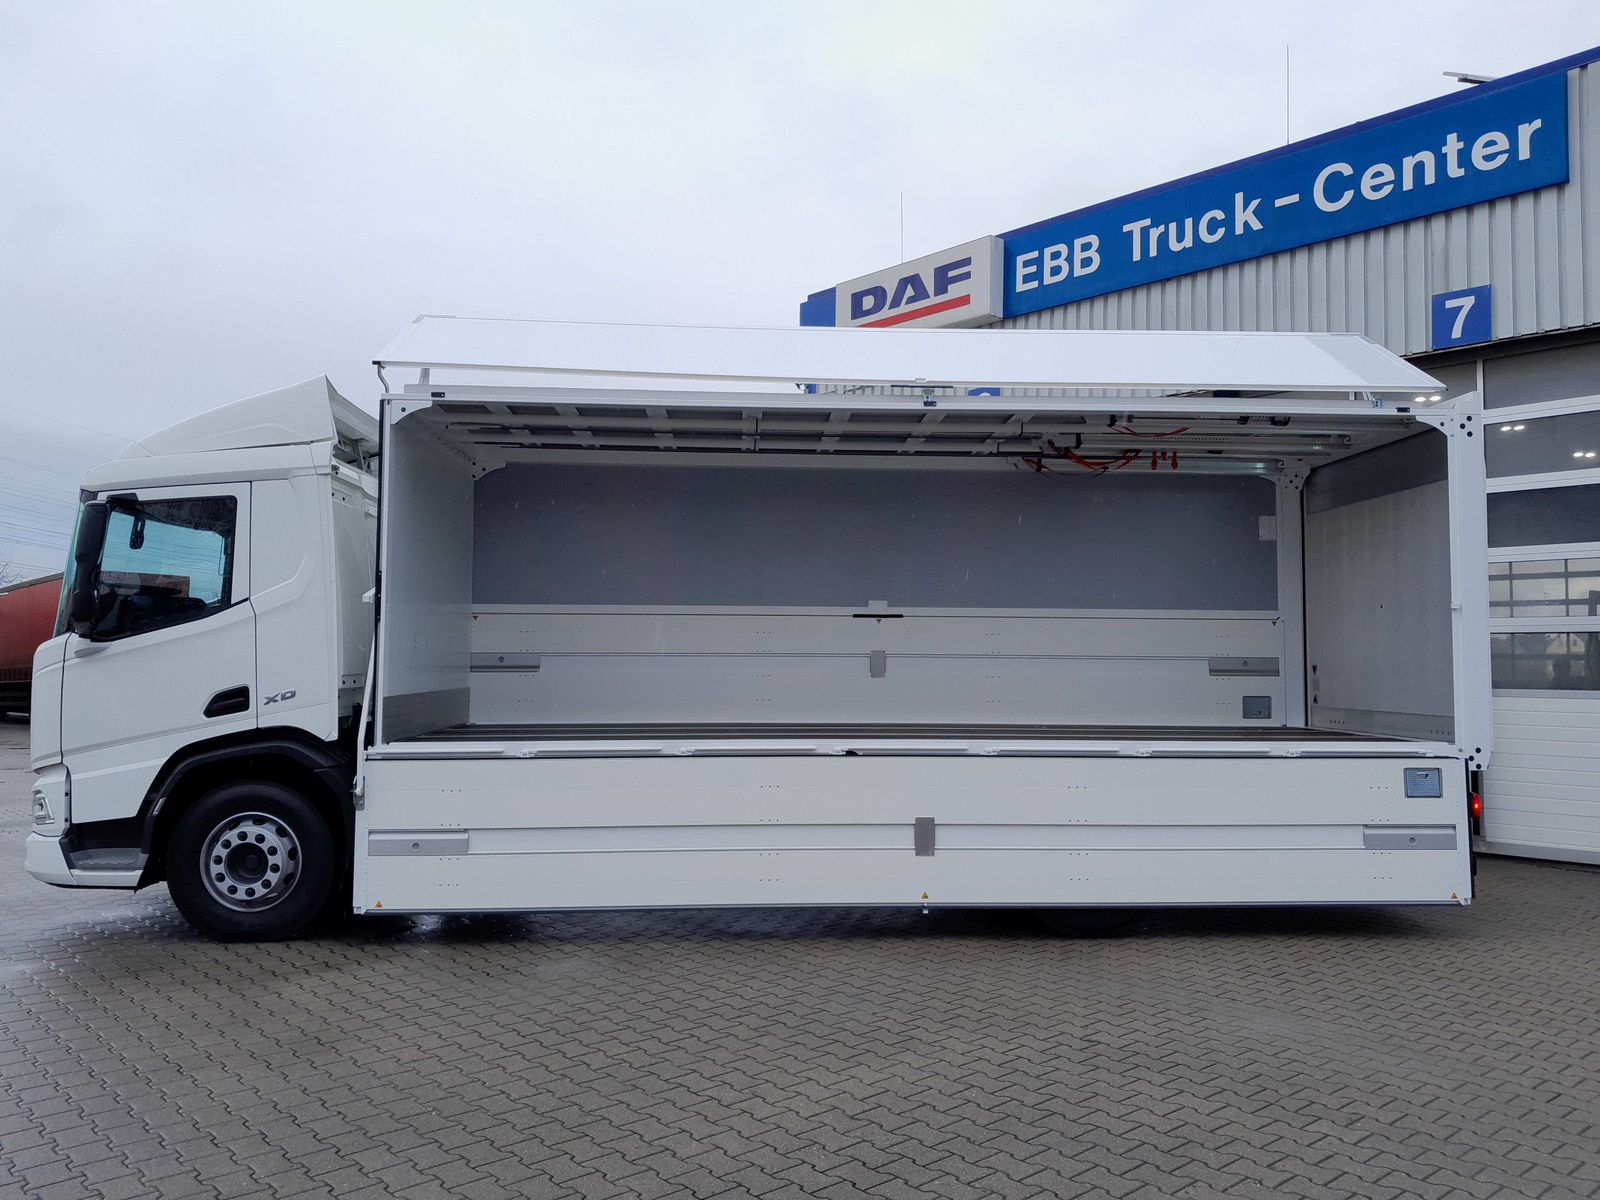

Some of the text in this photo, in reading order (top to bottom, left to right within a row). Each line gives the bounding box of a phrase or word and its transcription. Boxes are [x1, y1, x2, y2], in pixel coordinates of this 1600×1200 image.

[851, 256, 972, 321] DAF
[1015, 234, 1101, 293] EBB
[1445, 295, 1476, 340] 7
